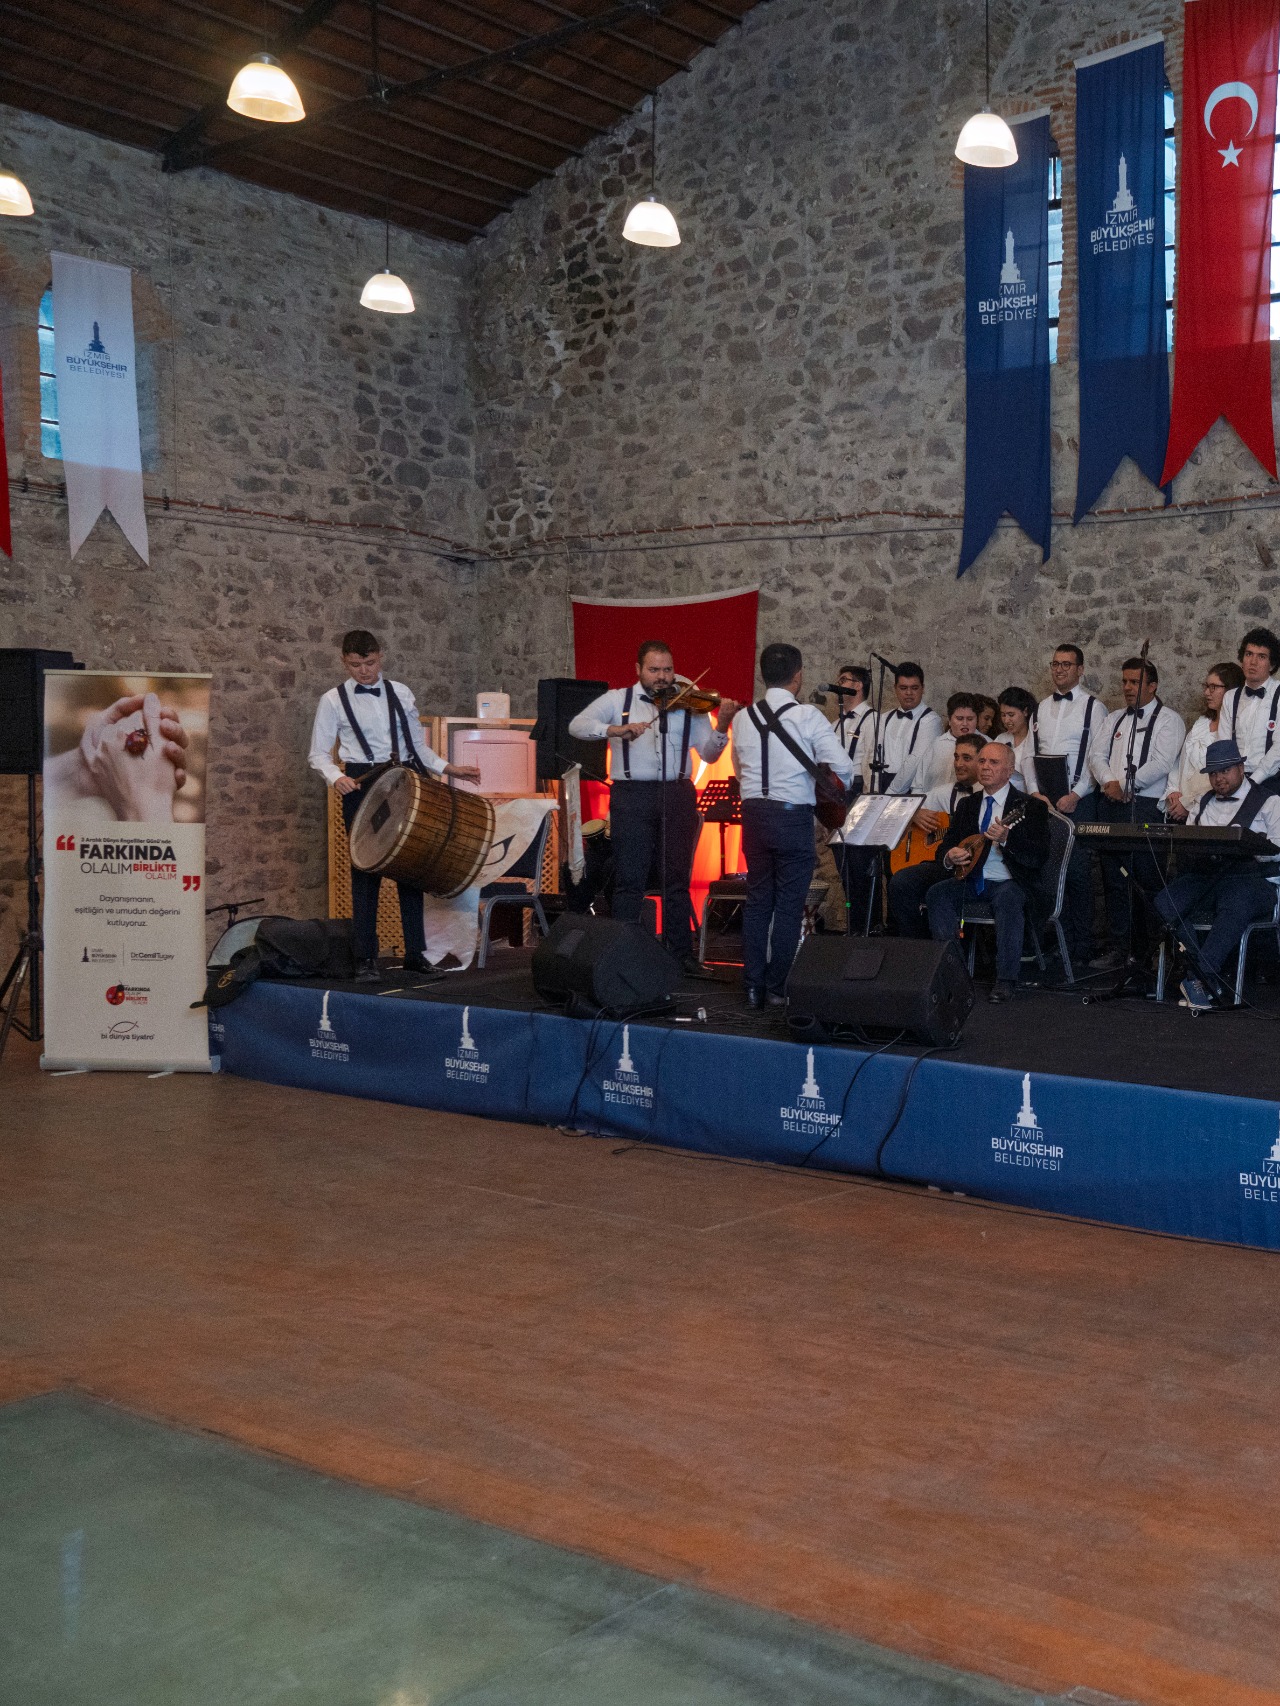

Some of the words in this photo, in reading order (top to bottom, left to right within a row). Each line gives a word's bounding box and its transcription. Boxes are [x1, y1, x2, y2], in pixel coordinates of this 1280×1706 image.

[1106, 209, 1137, 224] İZMİR
[1094, 233, 1153, 254] BELEDİYES
[1086, 825, 1110, 834] YAMAHA
[80, 844, 176, 861] FARKINDA
[80, 862, 132, 874] OLALIM
[133, 861, 177, 872] BİRLİKTE
[100, 895, 155, 904] Dayanışmanın,
[75, 907, 103, 915] eşitliğin
[148, 908, 180, 916] değerini
[445, 1057, 489, 1073] BÜYÜKŞEHİR
[447, 1070, 487, 1083] BELEDİYESİ
[603, 1080, 653, 1098] BÜYÜKŞEHİR
[605, 1093, 652, 1108] BELEDİYESİ
[797, 1097, 825, 1110] İZMİR
[781, 1106, 842, 1126] BÜYÜKŞEHİR
[784, 1121, 840, 1137] BELEDİYESİ
[1011, 1126, 1043, 1141] İZMİR
[992, 1137, 1063, 1158] BÜYÜKŞEHİR
[995, 1152, 1060, 1171] BELEDİYESİ
